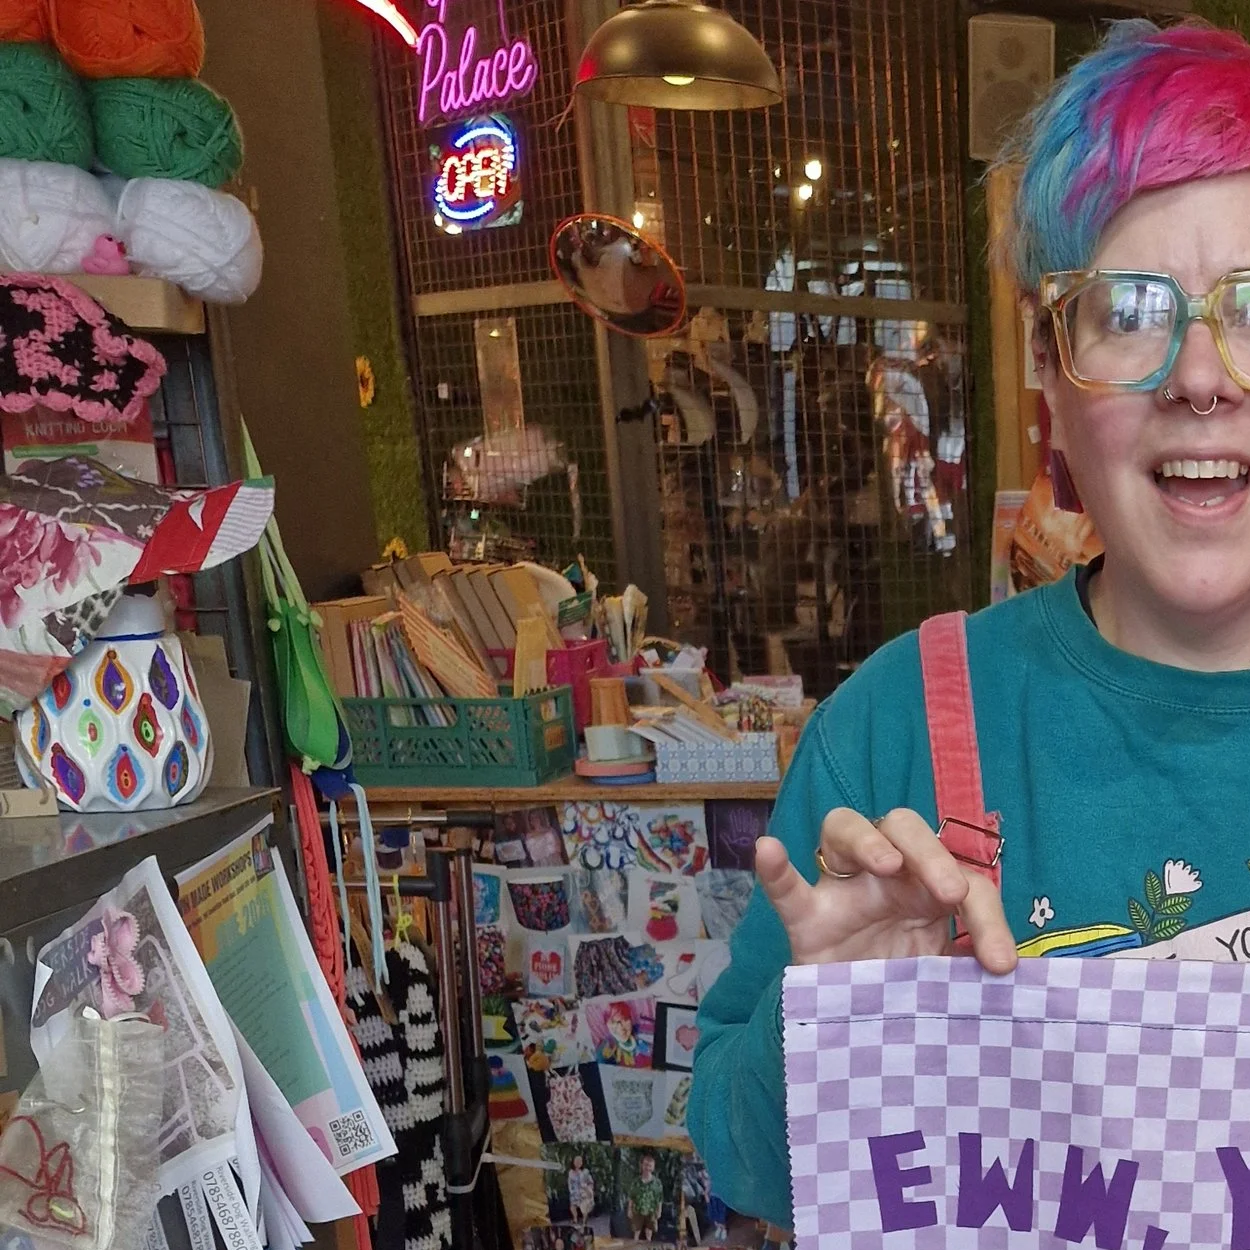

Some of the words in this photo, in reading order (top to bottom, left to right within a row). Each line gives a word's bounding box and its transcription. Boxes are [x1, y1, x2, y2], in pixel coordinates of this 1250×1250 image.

[416, 23, 535, 121] Palace
[441, 149, 511, 202] OPEN
[211, 849, 252, 896] WORKSHOPS
[216, 1165, 236, 1201] Riverside
[231, 1201, 242, 1223] Dog
[239, 1219, 259, 1250] Walking
